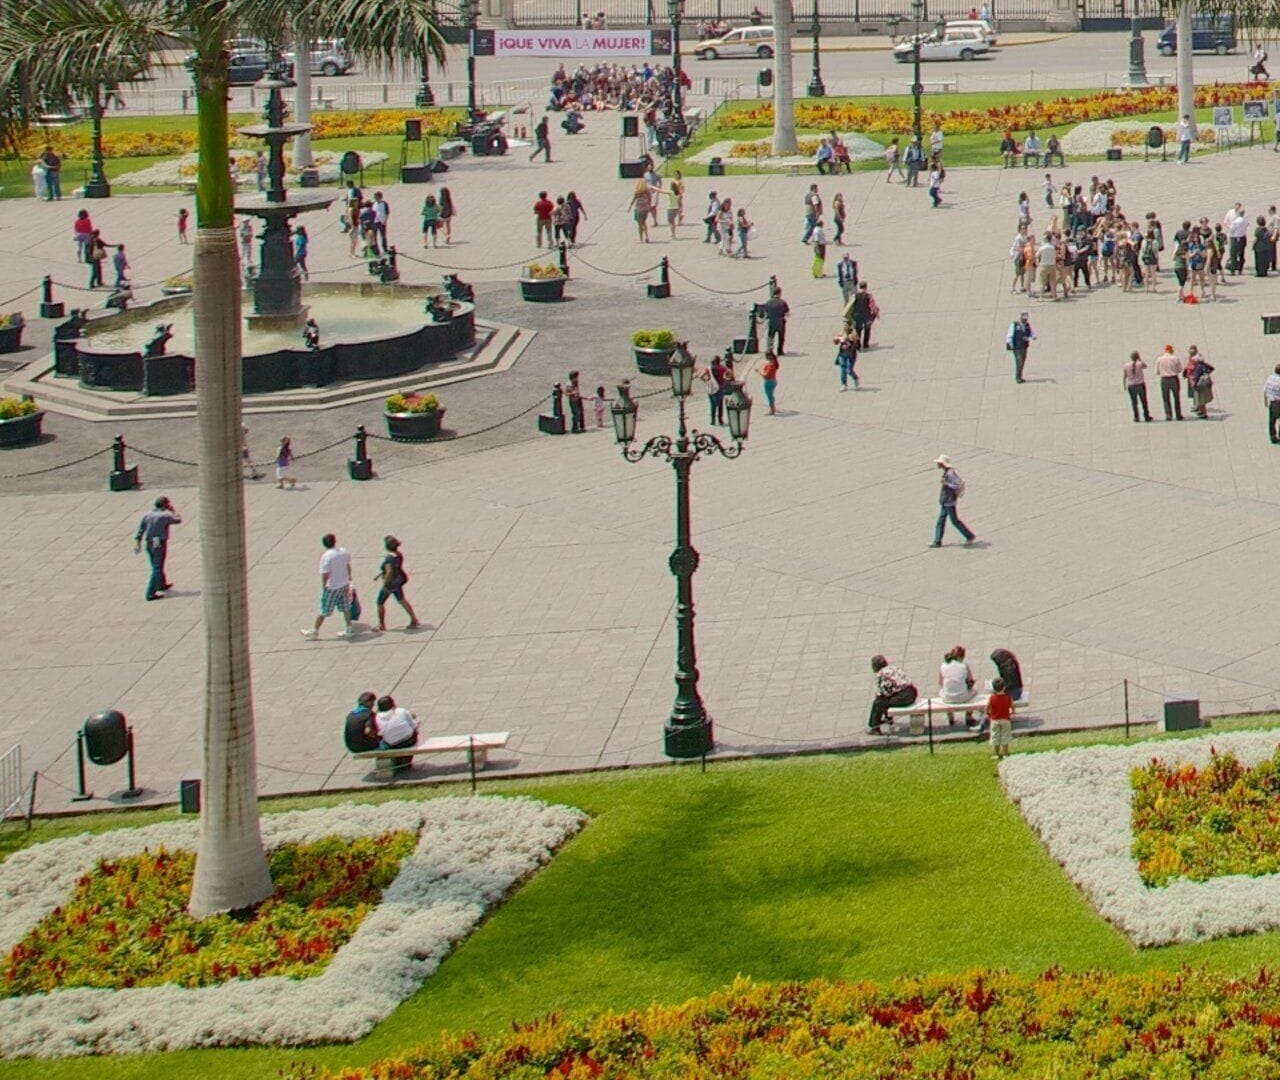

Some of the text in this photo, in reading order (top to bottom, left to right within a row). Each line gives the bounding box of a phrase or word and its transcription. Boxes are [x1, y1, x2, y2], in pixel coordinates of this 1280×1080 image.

[538, 38, 571, 49] VIVA
[575, 38, 590, 49] LA
[593, 37, 645, 49] MUJER!
